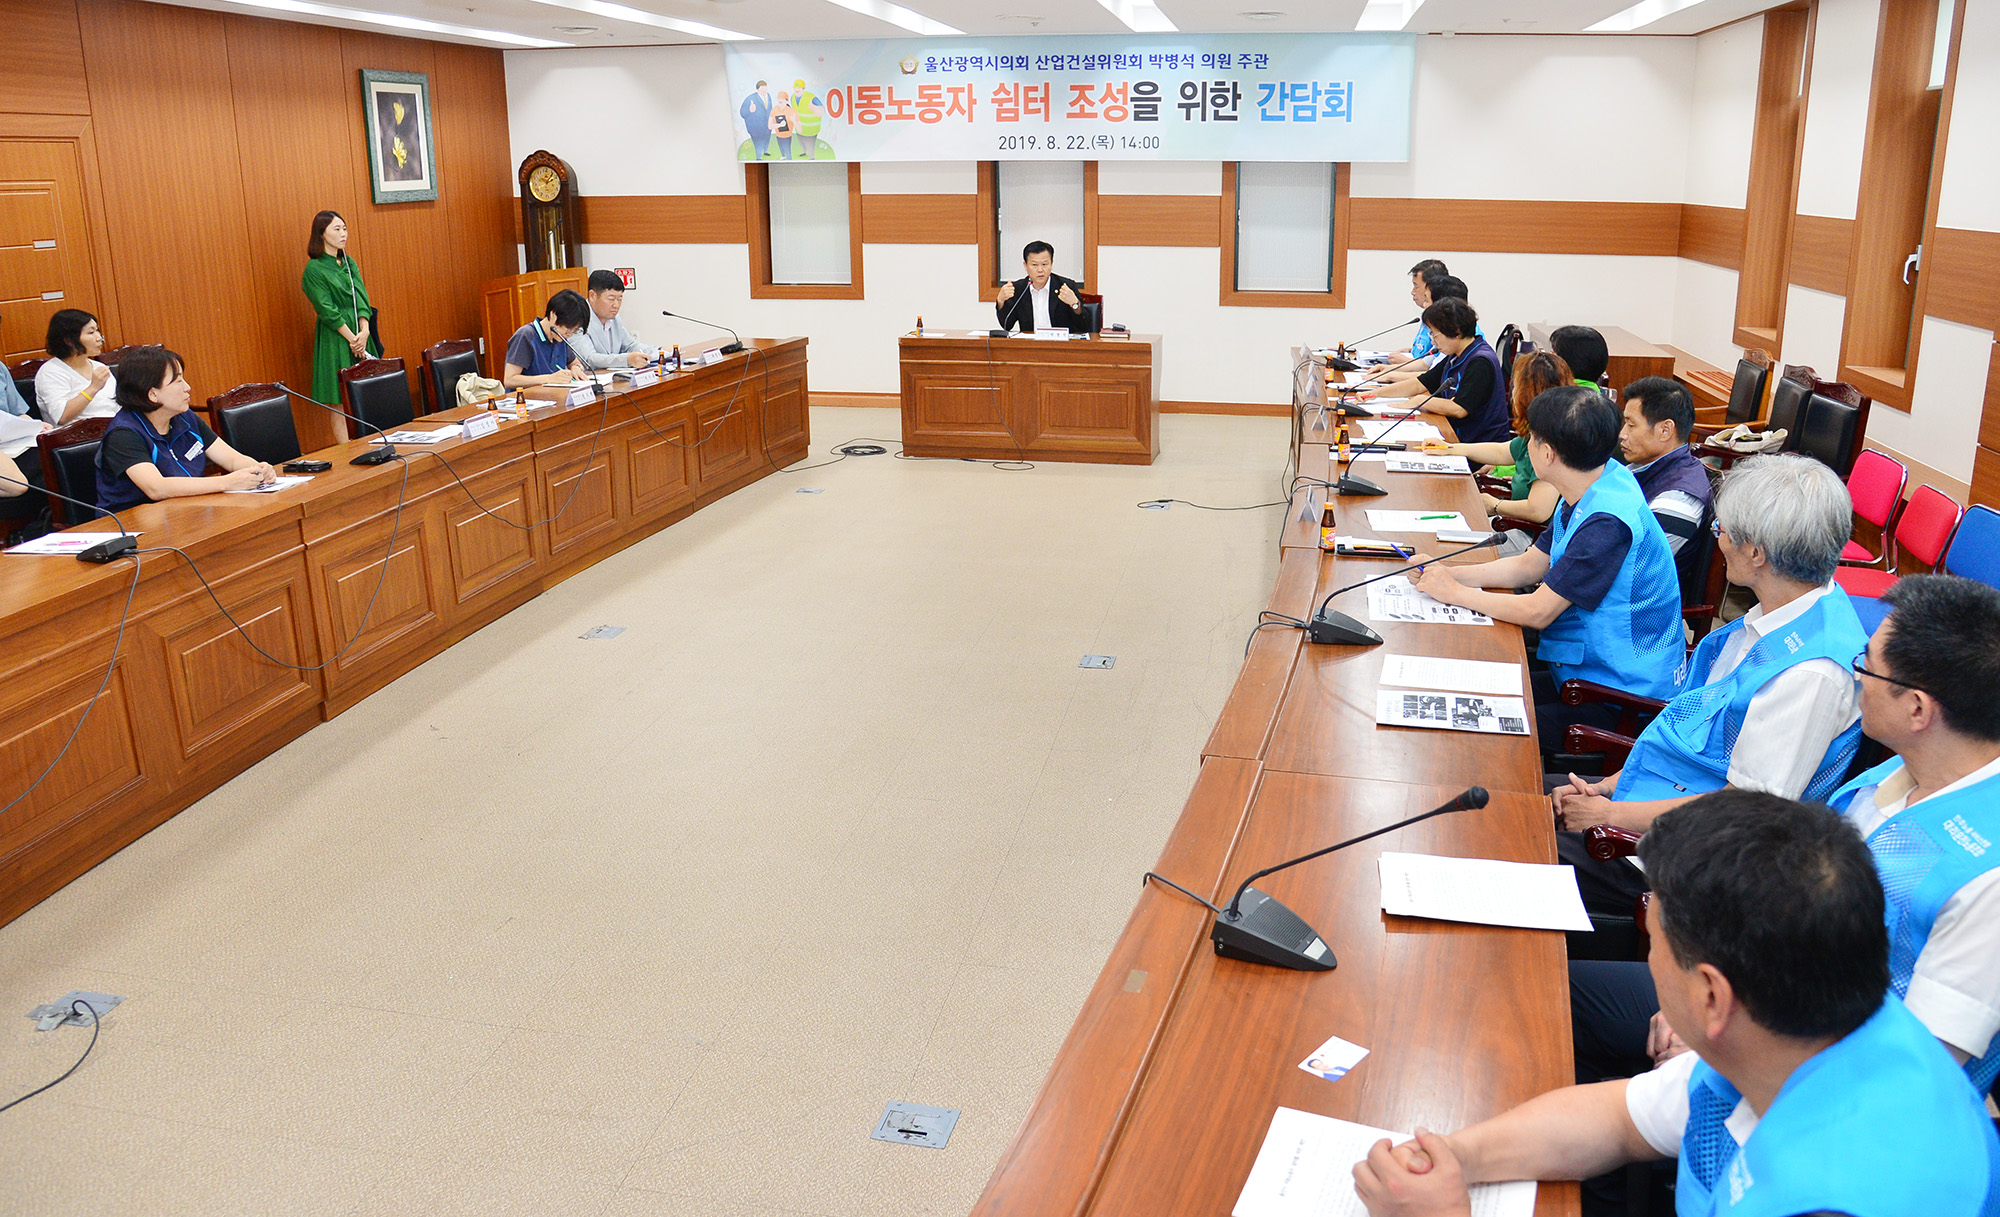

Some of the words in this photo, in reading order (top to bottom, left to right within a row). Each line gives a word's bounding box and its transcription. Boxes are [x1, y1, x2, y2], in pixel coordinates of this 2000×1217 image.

[925, 55, 1029, 73] 울산광역시의회
[1035, 53, 1143, 71] 산업건설위원회
[1149, 53, 1195, 70] 박병석
[1201, 53, 1232, 70] 의원
[1238, 53, 1270, 70] 주관
[827, 83, 977, 125] 이동노동자
[991, 82, 1051, 122] 쉼터
[1067, 81, 1162, 122] 조성을
[1178, 81, 1242, 122] 위한
[1257, 81, 1353, 123] 간담회
[998, 135, 1041, 150] 2019.
[1047, 135, 1061, 150] 8.
[1066, 135, 1117, 152] 22.(목)
[1121, 136, 1161, 149] 14:00
